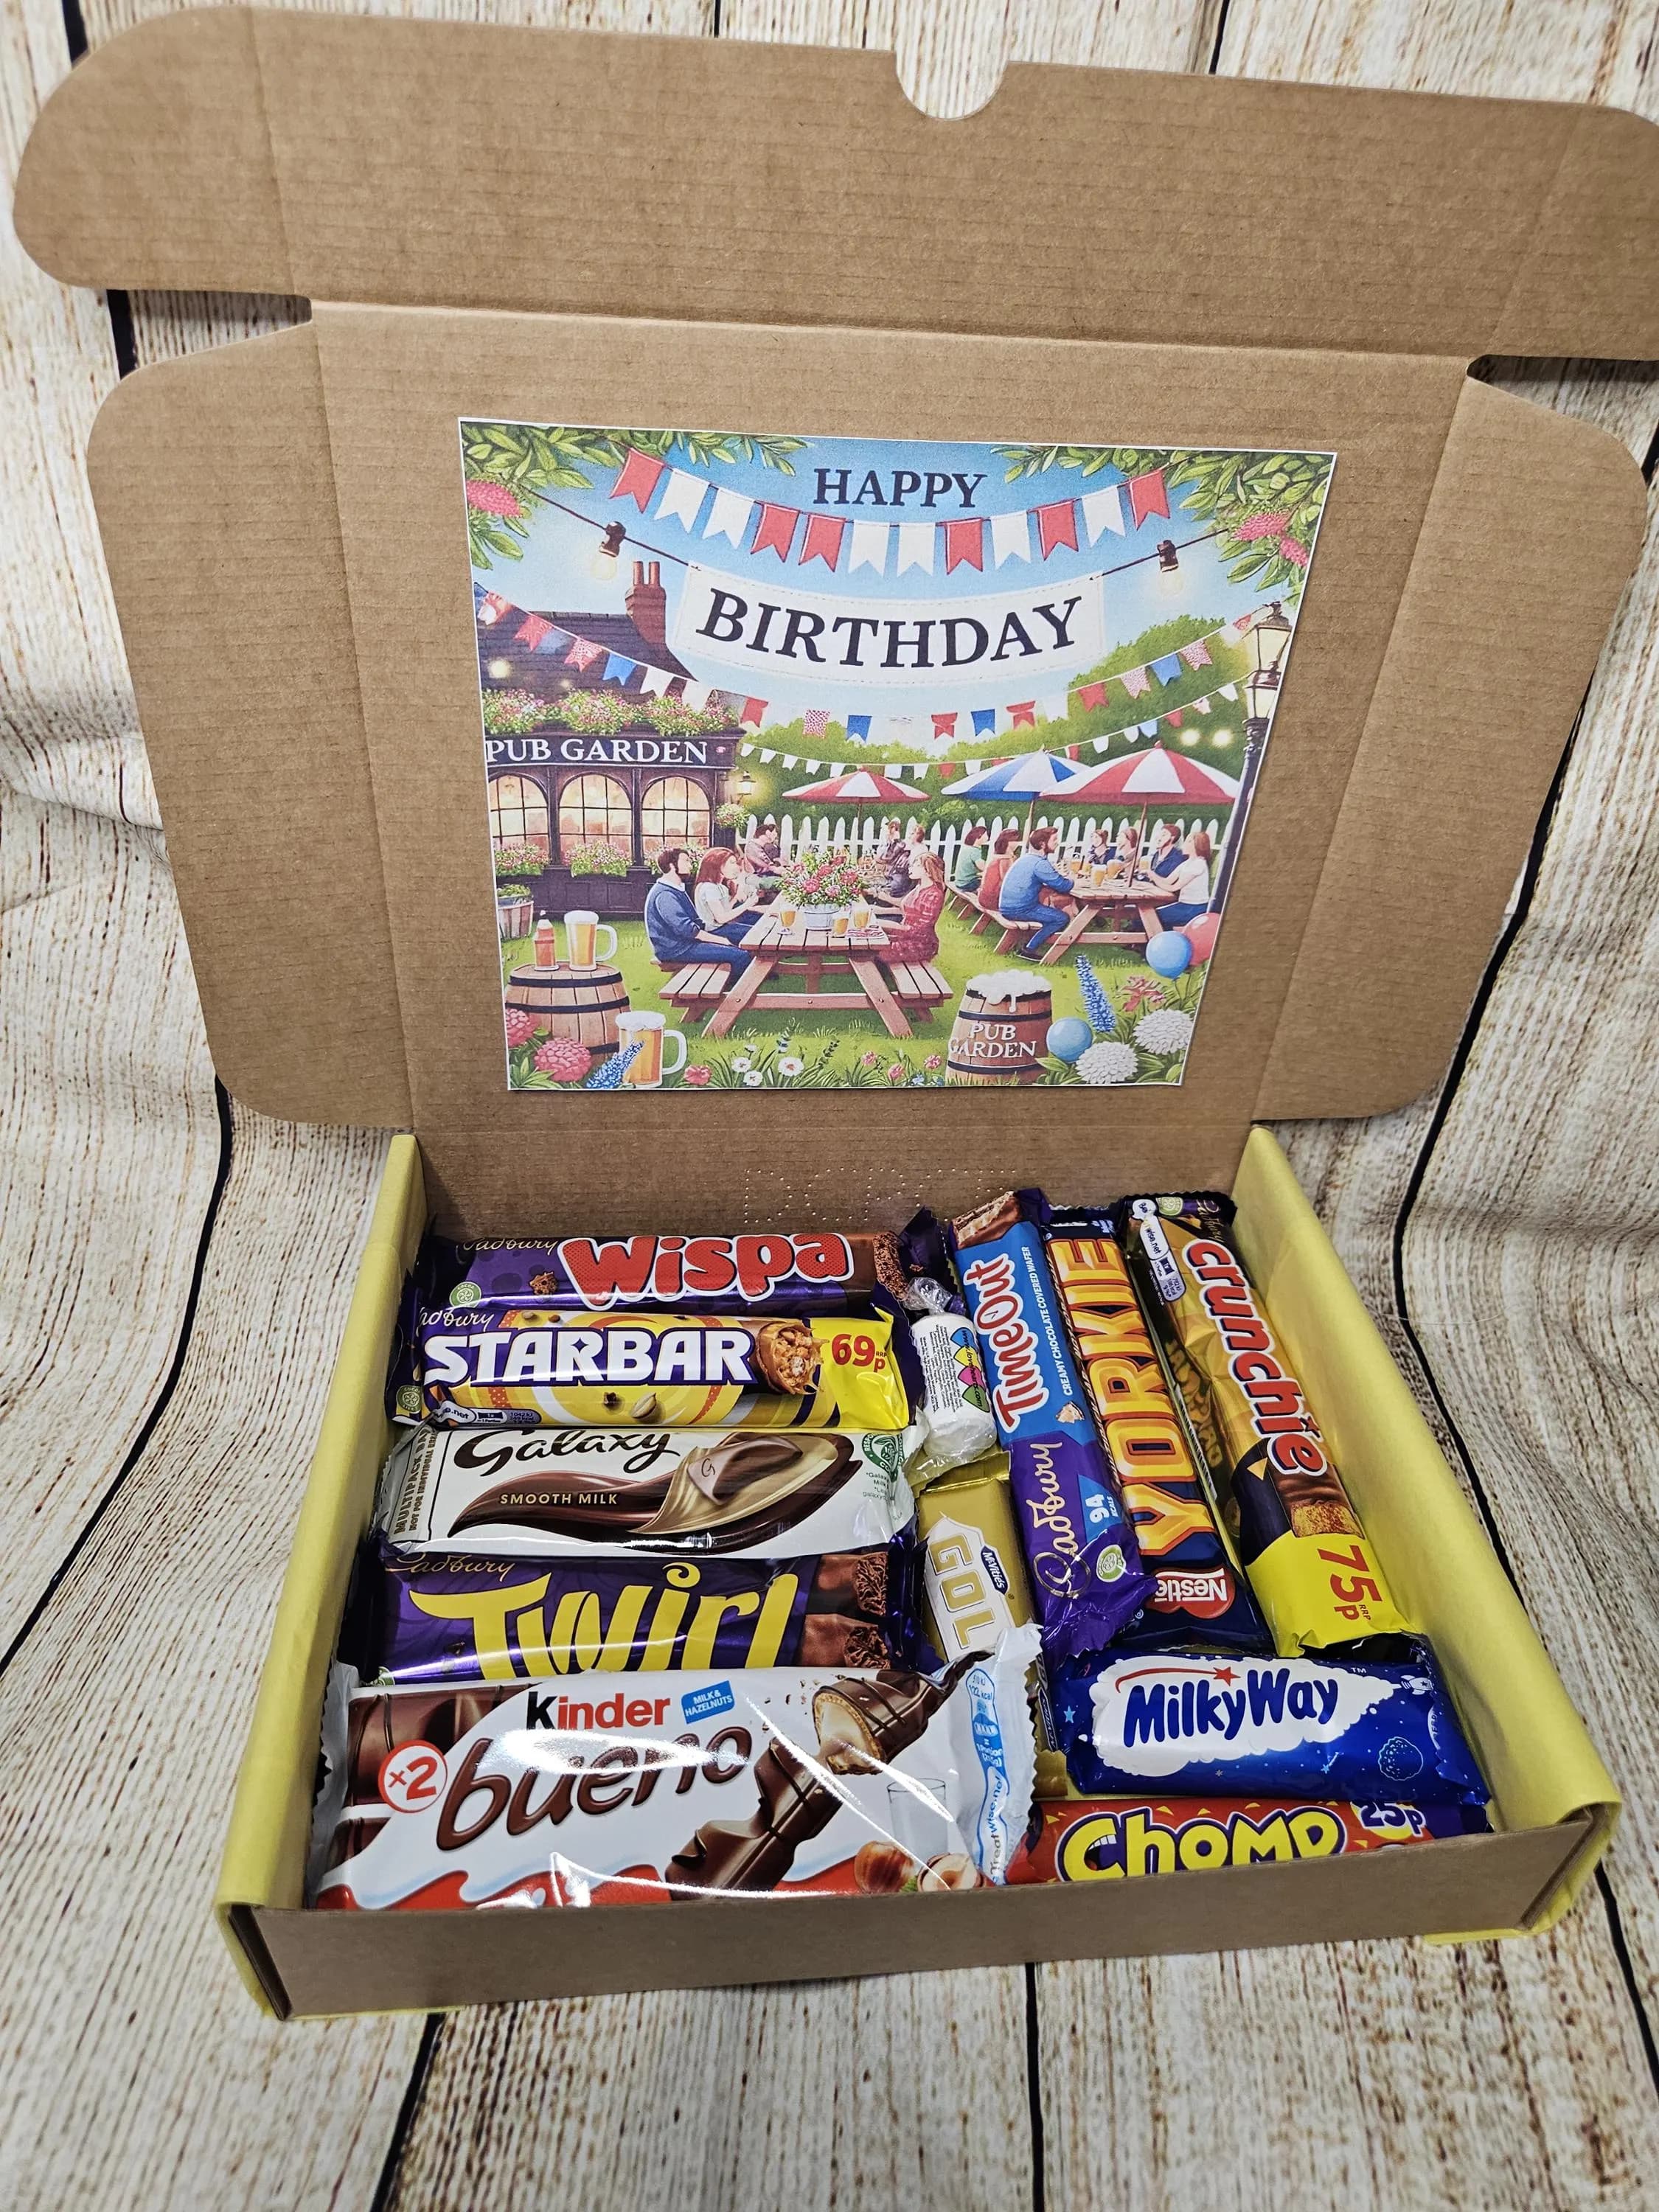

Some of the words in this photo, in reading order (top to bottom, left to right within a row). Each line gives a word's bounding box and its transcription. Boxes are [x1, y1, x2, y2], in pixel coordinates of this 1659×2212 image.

[813, 467, 987, 508] HAPPY
[696, 587, 1082, 668] BIRTHDAY
[486, 740, 552, 762] PUB
[560, 739, 708, 765] GARDEN
[948, 1038, 1037, 1058] GARDEN
[968, 1023, 1016, 1040] PUB
[559, 1233, 853, 1310] Wispa
[1021, 1246, 1033, 1272] WAFER
[1028, 1269, 1043, 1309] COVERED
[1038, 1307, 1062, 1362] CHOCOLATE
[424, 1329, 754, 1386] STARBAR
[1055, 1358, 1074, 1396] CREAMY
[1183, 1239, 1327, 1476] Crunchie
[1048, 1239, 1215, 1556] YORKIE
[453, 1430, 681, 1477] Galaxy
[392, 1452, 425, 1536] MULTIPACK
[412, 1494, 425, 1513] FOR
[500, 1492, 572, 1505] SMOOTH
[577, 1493, 618, 1505] MILK
[1085, 1494, 1110, 1523] 94
[408, 1512, 421, 1532] NOT
[1026, 1442, 1091, 1598] Cadbury
[386, 1551, 515, 1582] Cadbury
[1317, 1545, 1383, 1621] 75p
[928, 1534, 995, 1649] GOL
[408, 1562, 799, 1680] Twirl
[526, 1691, 670, 1731] Kinder
[684, 1695, 733, 1717] HAZELNUTS
[693, 1691, 715, 1705] MILK
[714, 1689, 722, 1697] &
[436, 1726, 751, 1851] bueno
[1360, 1801, 1425, 1837] 25p
